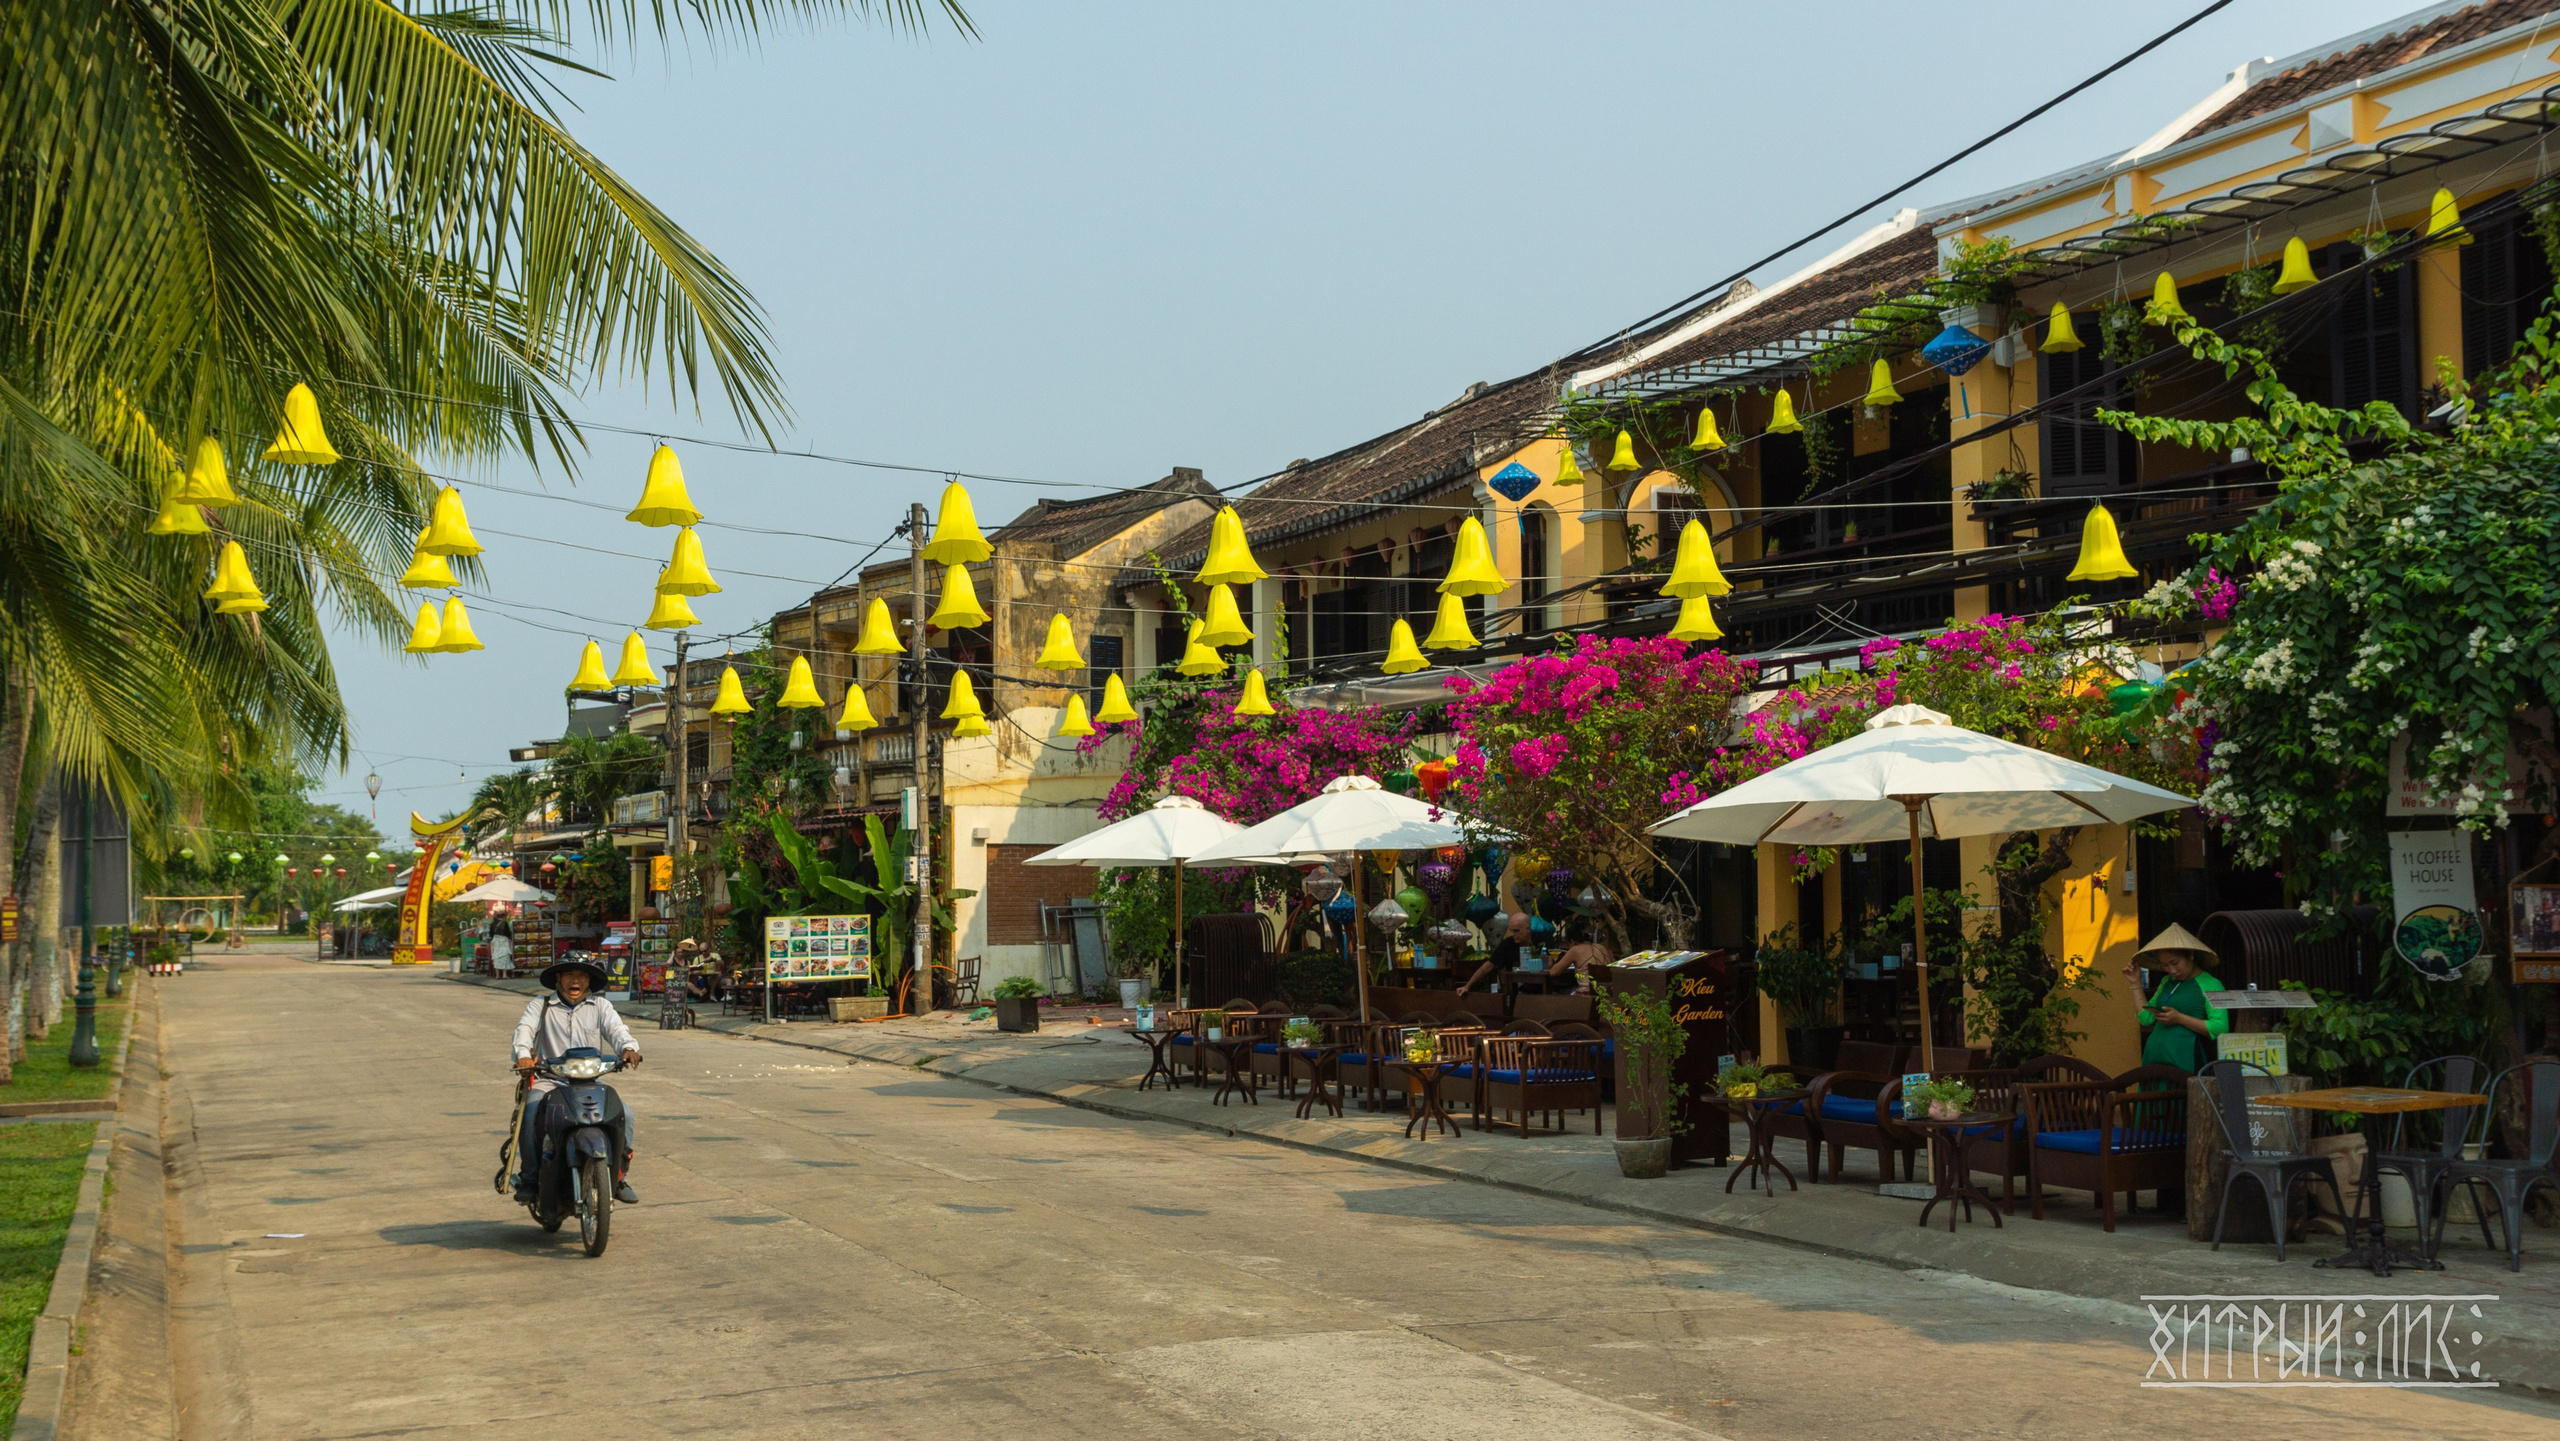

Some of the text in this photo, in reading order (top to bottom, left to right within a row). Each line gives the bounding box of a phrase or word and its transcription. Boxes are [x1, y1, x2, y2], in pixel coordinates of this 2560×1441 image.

[2402, 850, 2462, 865] 11 COFFEE
[2410, 868, 2455, 883] HOUSE
[1680, 977, 1715, 998] Kieu
[1671, 1003, 1724, 1027] Garden
